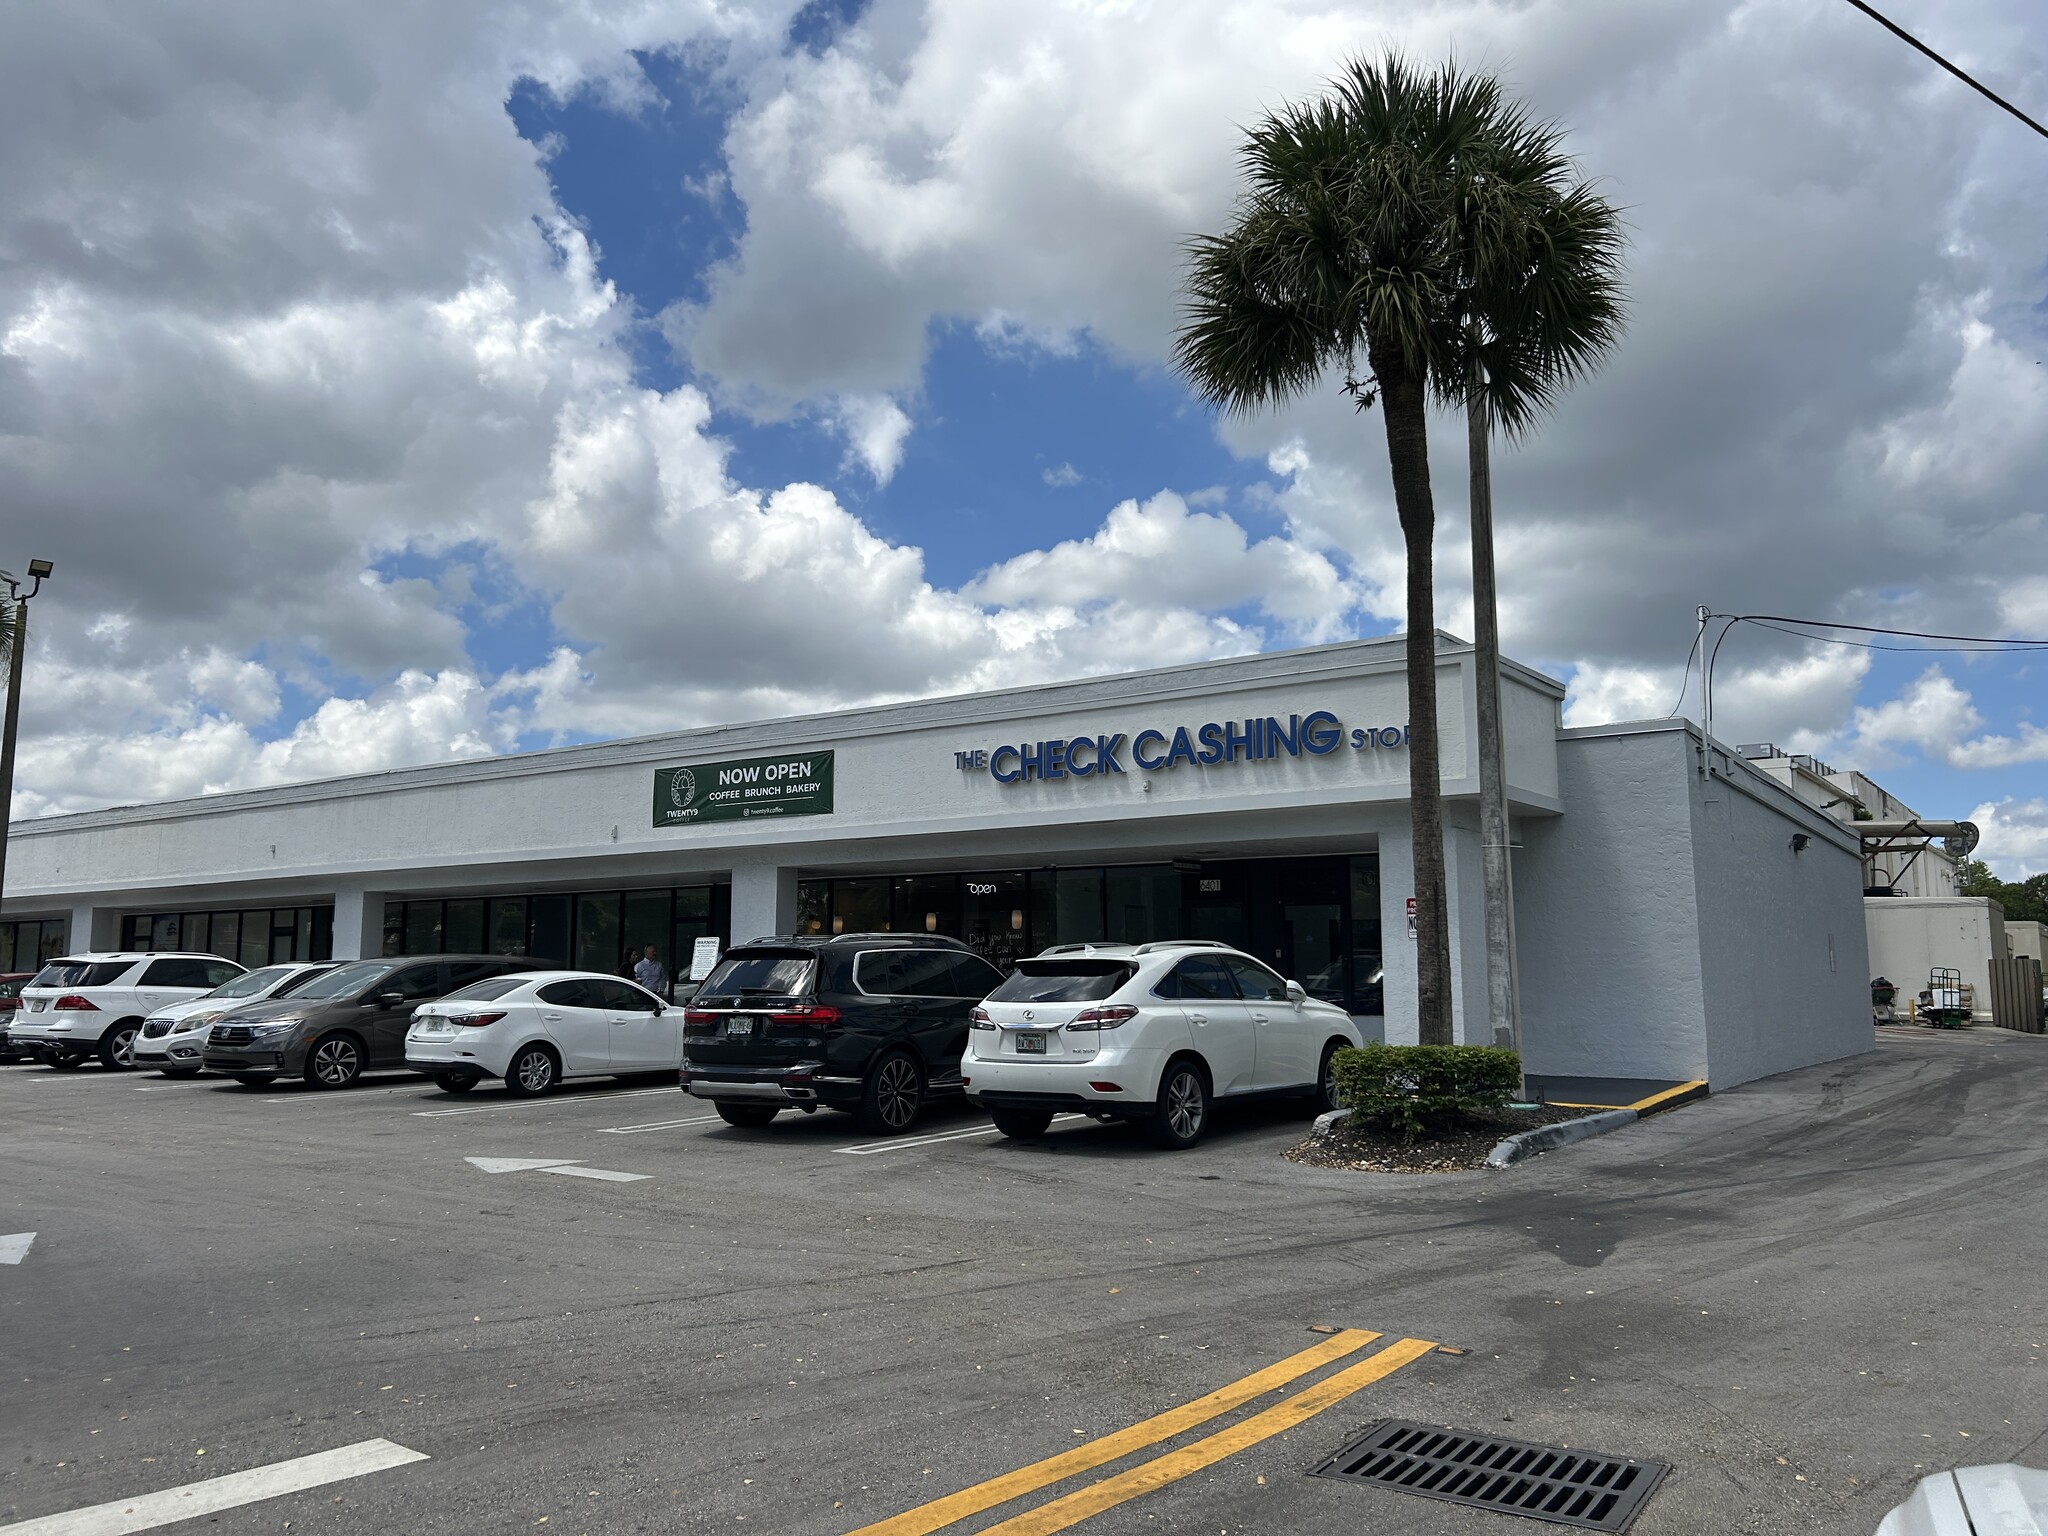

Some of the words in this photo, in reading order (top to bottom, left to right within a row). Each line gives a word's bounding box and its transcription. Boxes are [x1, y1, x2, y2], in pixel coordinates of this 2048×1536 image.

[953, 749, 987, 770] THE
[990, 733, 1127, 784] CHECK
[1132, 710, 1344, 770] CASHING
[719, 766, 761, 785] NOW
[765, 761, 812, 780] OPEN
[709, 789, 740, 801] COFFEE
[745, 786, 781, 798] BRUNCH
[786, 782, 822, 794] BAKERY
[666, 808, 699, 819] TWENTY9
[750, 805, 785, 816] twenty9.coffee
[1200, 880, 1220, 891] 6401
[968, 931, 986, 946] Did
